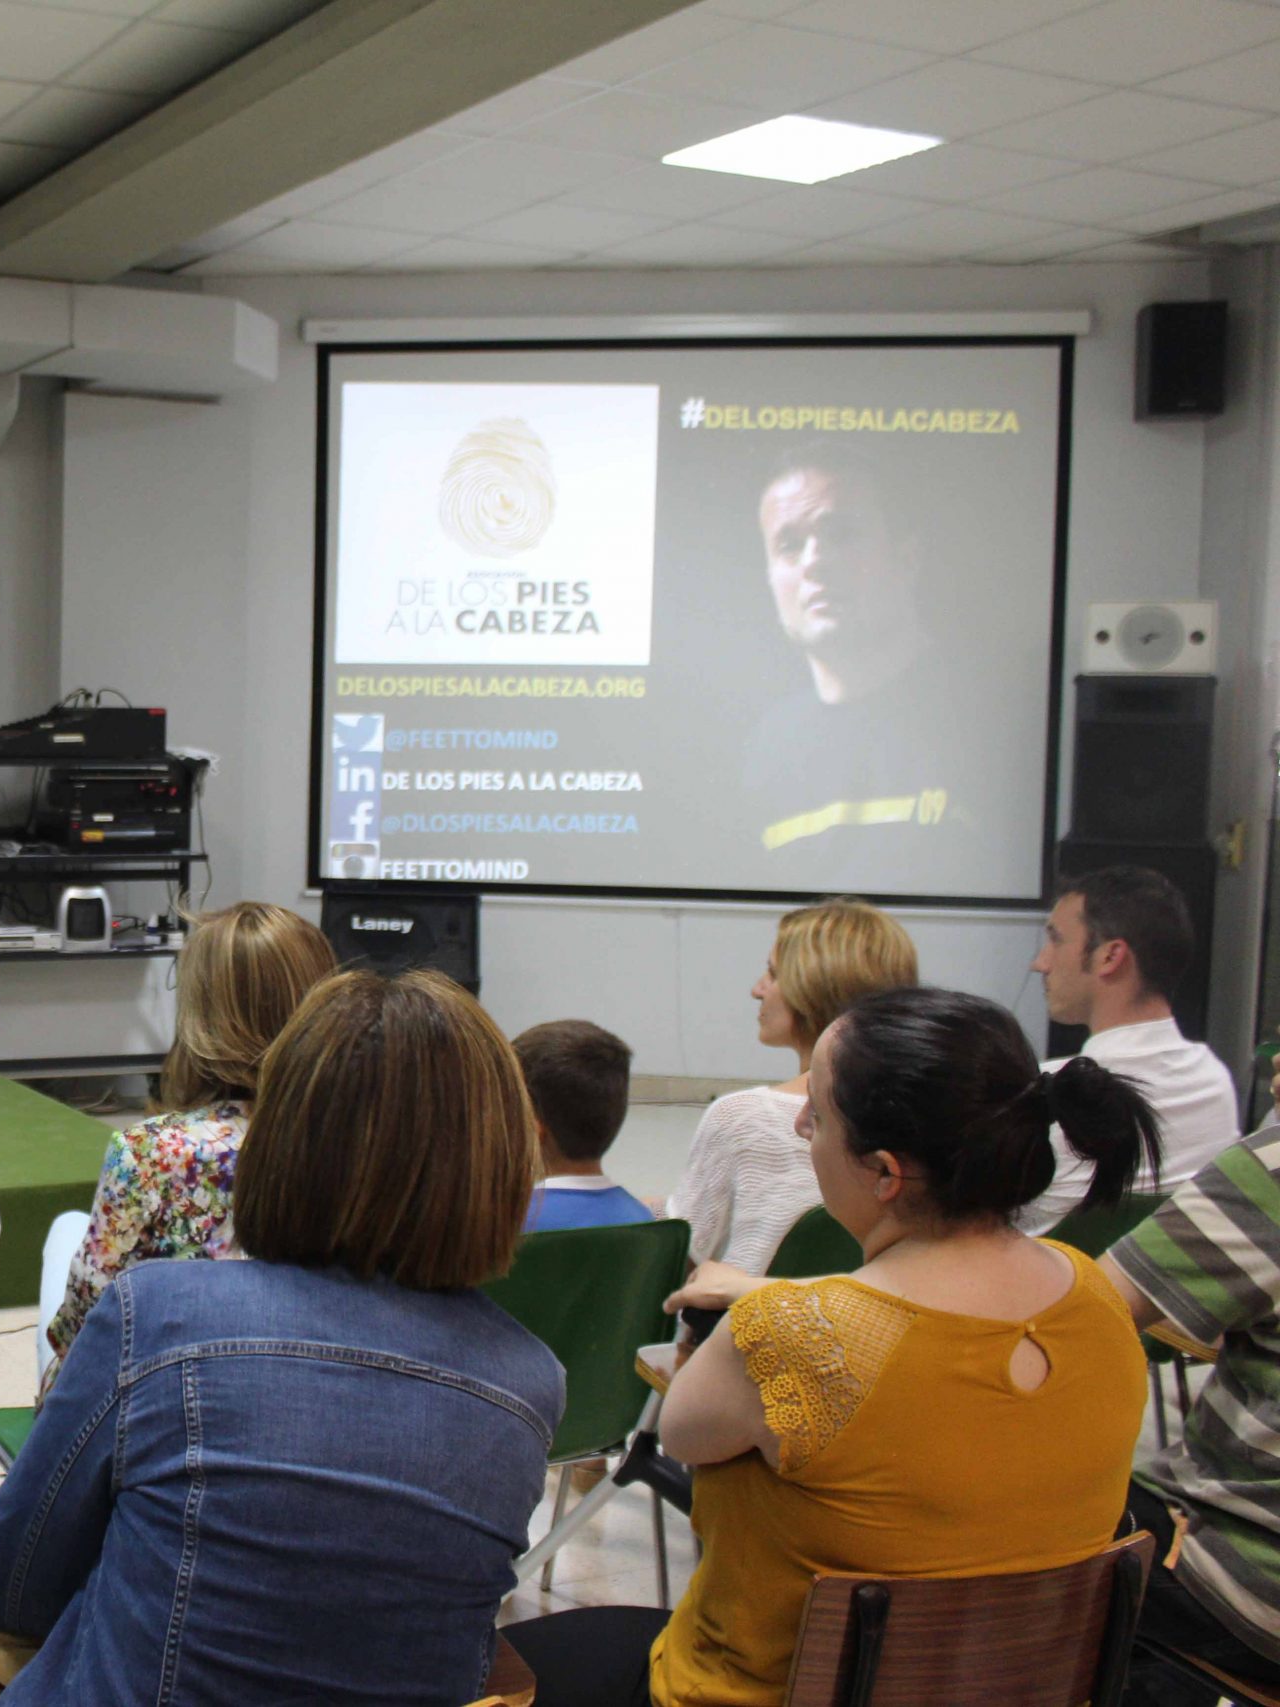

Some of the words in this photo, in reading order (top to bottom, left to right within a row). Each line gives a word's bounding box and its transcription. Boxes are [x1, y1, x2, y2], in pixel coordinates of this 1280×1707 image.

[680, 397, 1020, 434] #DELOSPIESALACABEZA
[397, 580, 437, 606] DE
[448, 580, 508, 606] LOS
[516, 581, 591, 606] PIES
[384, 609, 408, 635] A
[454, 609, 601, 635] CABEZA
[336, 676, 647, 698] DELOSPIESALACABEZA.ORG
[385, 728, 559, 751] @FEETTOMIND
[382, 771, 410, 791] DE
[415, 771, 455, 791] LOS
[459, 771, 505, 791] PIES
[508, 771, 525, 791] A
[529, 771, 556, 791] LA
[560, 771, 644, 792] CABEZA
[381, 814, 639, 834] @DLOSPIESALACABEZA
[379, 858, 529, 880] FEETTOMIND
[352, 915, 414, 934] Laney
